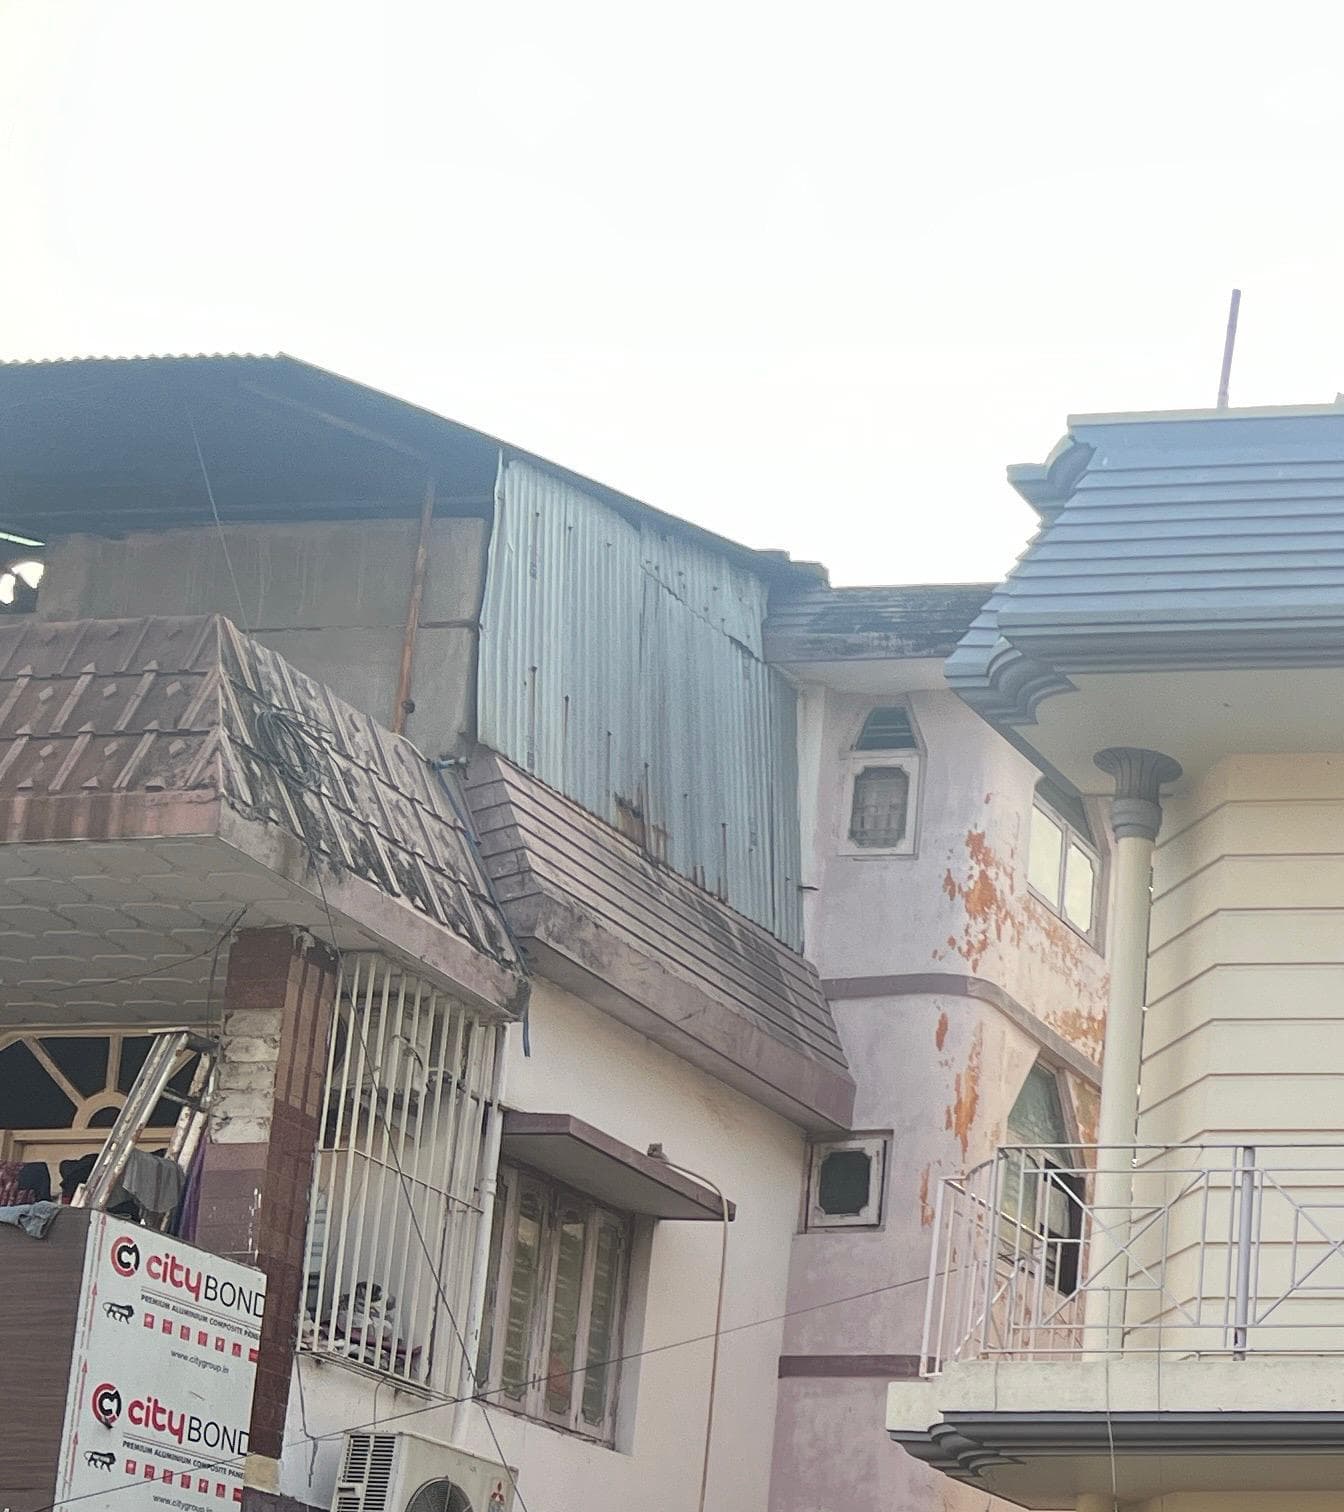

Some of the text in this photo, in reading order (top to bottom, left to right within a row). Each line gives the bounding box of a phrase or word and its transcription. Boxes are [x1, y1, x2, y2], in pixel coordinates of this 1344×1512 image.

[170, 1350, 230, 1374] www.citygroup.in
[122, 1440, 153, 1455] PREMIUM
[154, 1450, 192, 1465] ALUMINIUM
